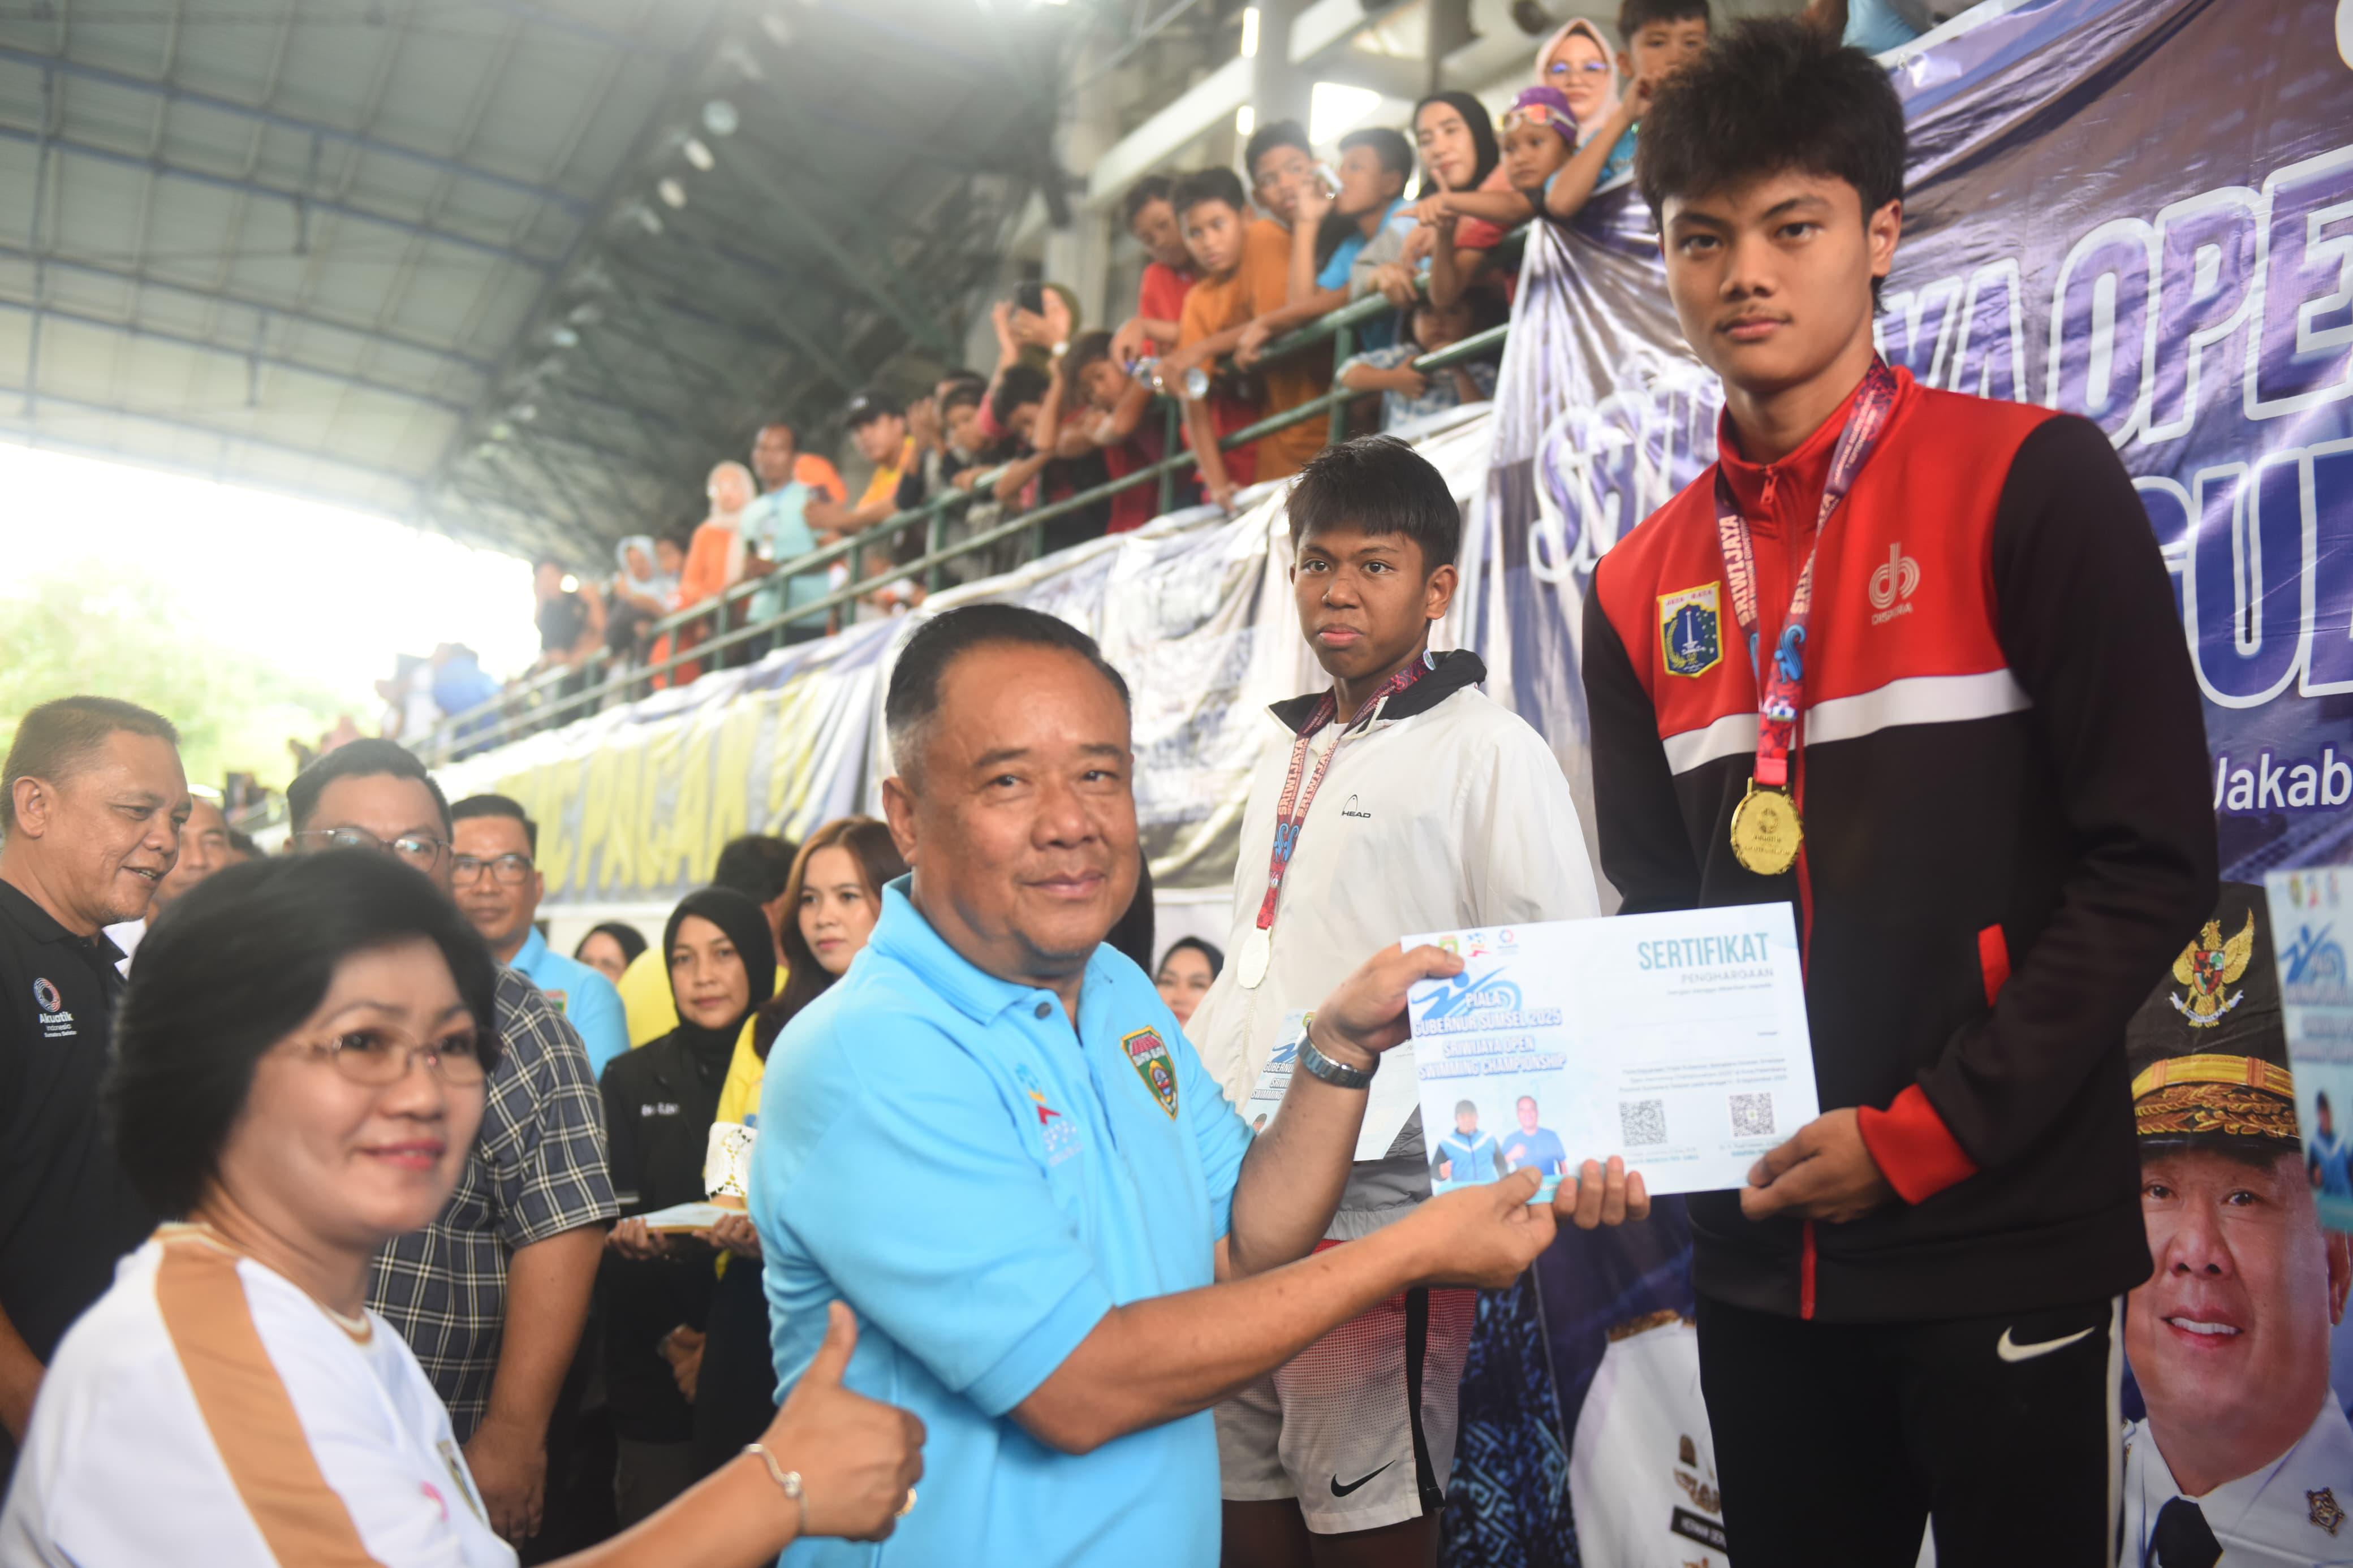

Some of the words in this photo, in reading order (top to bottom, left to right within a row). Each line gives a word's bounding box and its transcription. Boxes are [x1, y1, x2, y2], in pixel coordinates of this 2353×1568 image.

[1719, 515, 1751, 627] SRIWIJAYA
[1278, 738, 1305, 815] SRIWIJAYA
[2213, 748, 2352, 811] Jakab
[1637, 932, 1769, 971] SERTIFIKAT
[1681, 968, 1774, 984] PENGHARGAAN
[1465, 991, 1502, 1009] PIALA
[40, 1011, 74, 1024] Akuatik
[1415, 1014, 1478, 1036] GUBERNUR
[1480, 1010, 1527, 1031] SUMSEL
[1528, 1008, 1563, 1027] 2025
[1444, 1038, 1502, 1059] SRIWIJAYA
[1505, 1035, 1536, 1053] OPEN
[1264, 1062, 1294, 1074] GUBERNU
[1418, 1060, 1480, 1080] SWIMMING
[1482, 1052, 1566, 1075] CHAMPIONSHIP
[1251, 1089, 1283, 1101] SWIMMING
